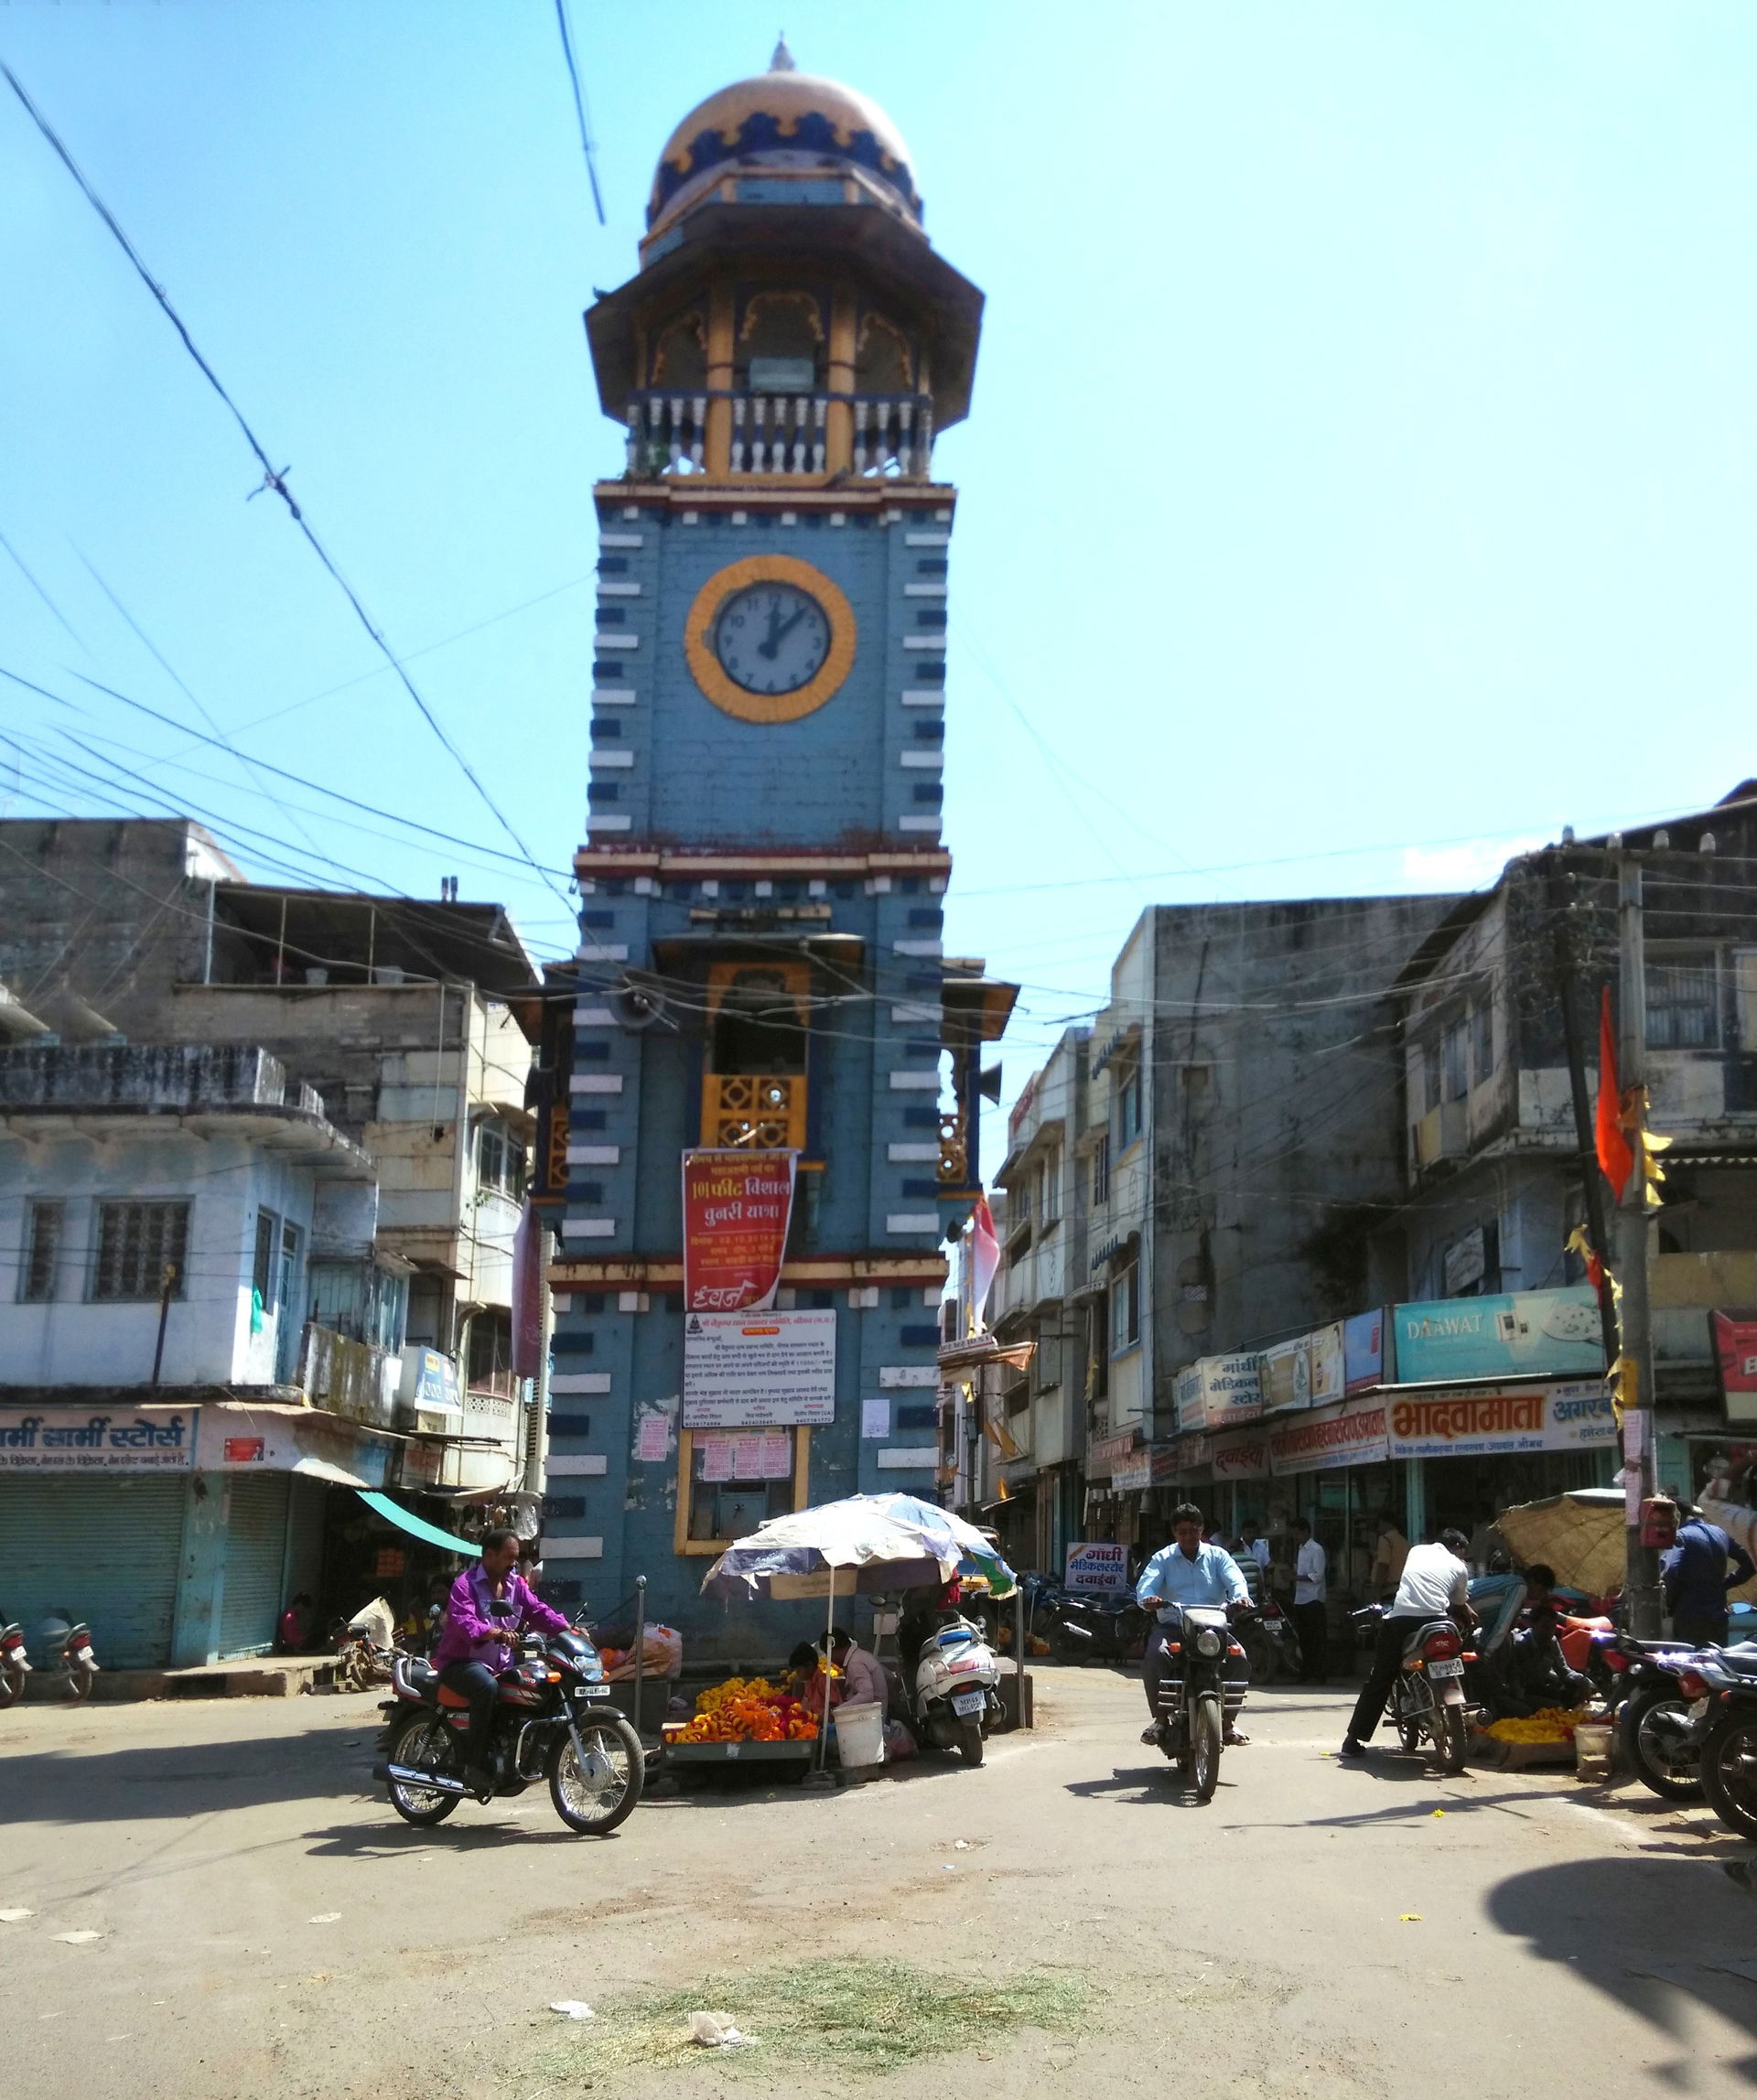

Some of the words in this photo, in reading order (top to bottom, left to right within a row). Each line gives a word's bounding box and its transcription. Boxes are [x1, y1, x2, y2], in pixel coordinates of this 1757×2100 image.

[745, 1176, 790, 1196] विशाल
[705, 1201, 742, 1227] चुनरी
[747, 1205, 780, 1219] यात्रा
[1231, 1391, 1261, 1405] स्टोर
[1394, 1396, 1544, 1438] भादवामाता
[110, 1416, 186, 1448] स्टोर्स
